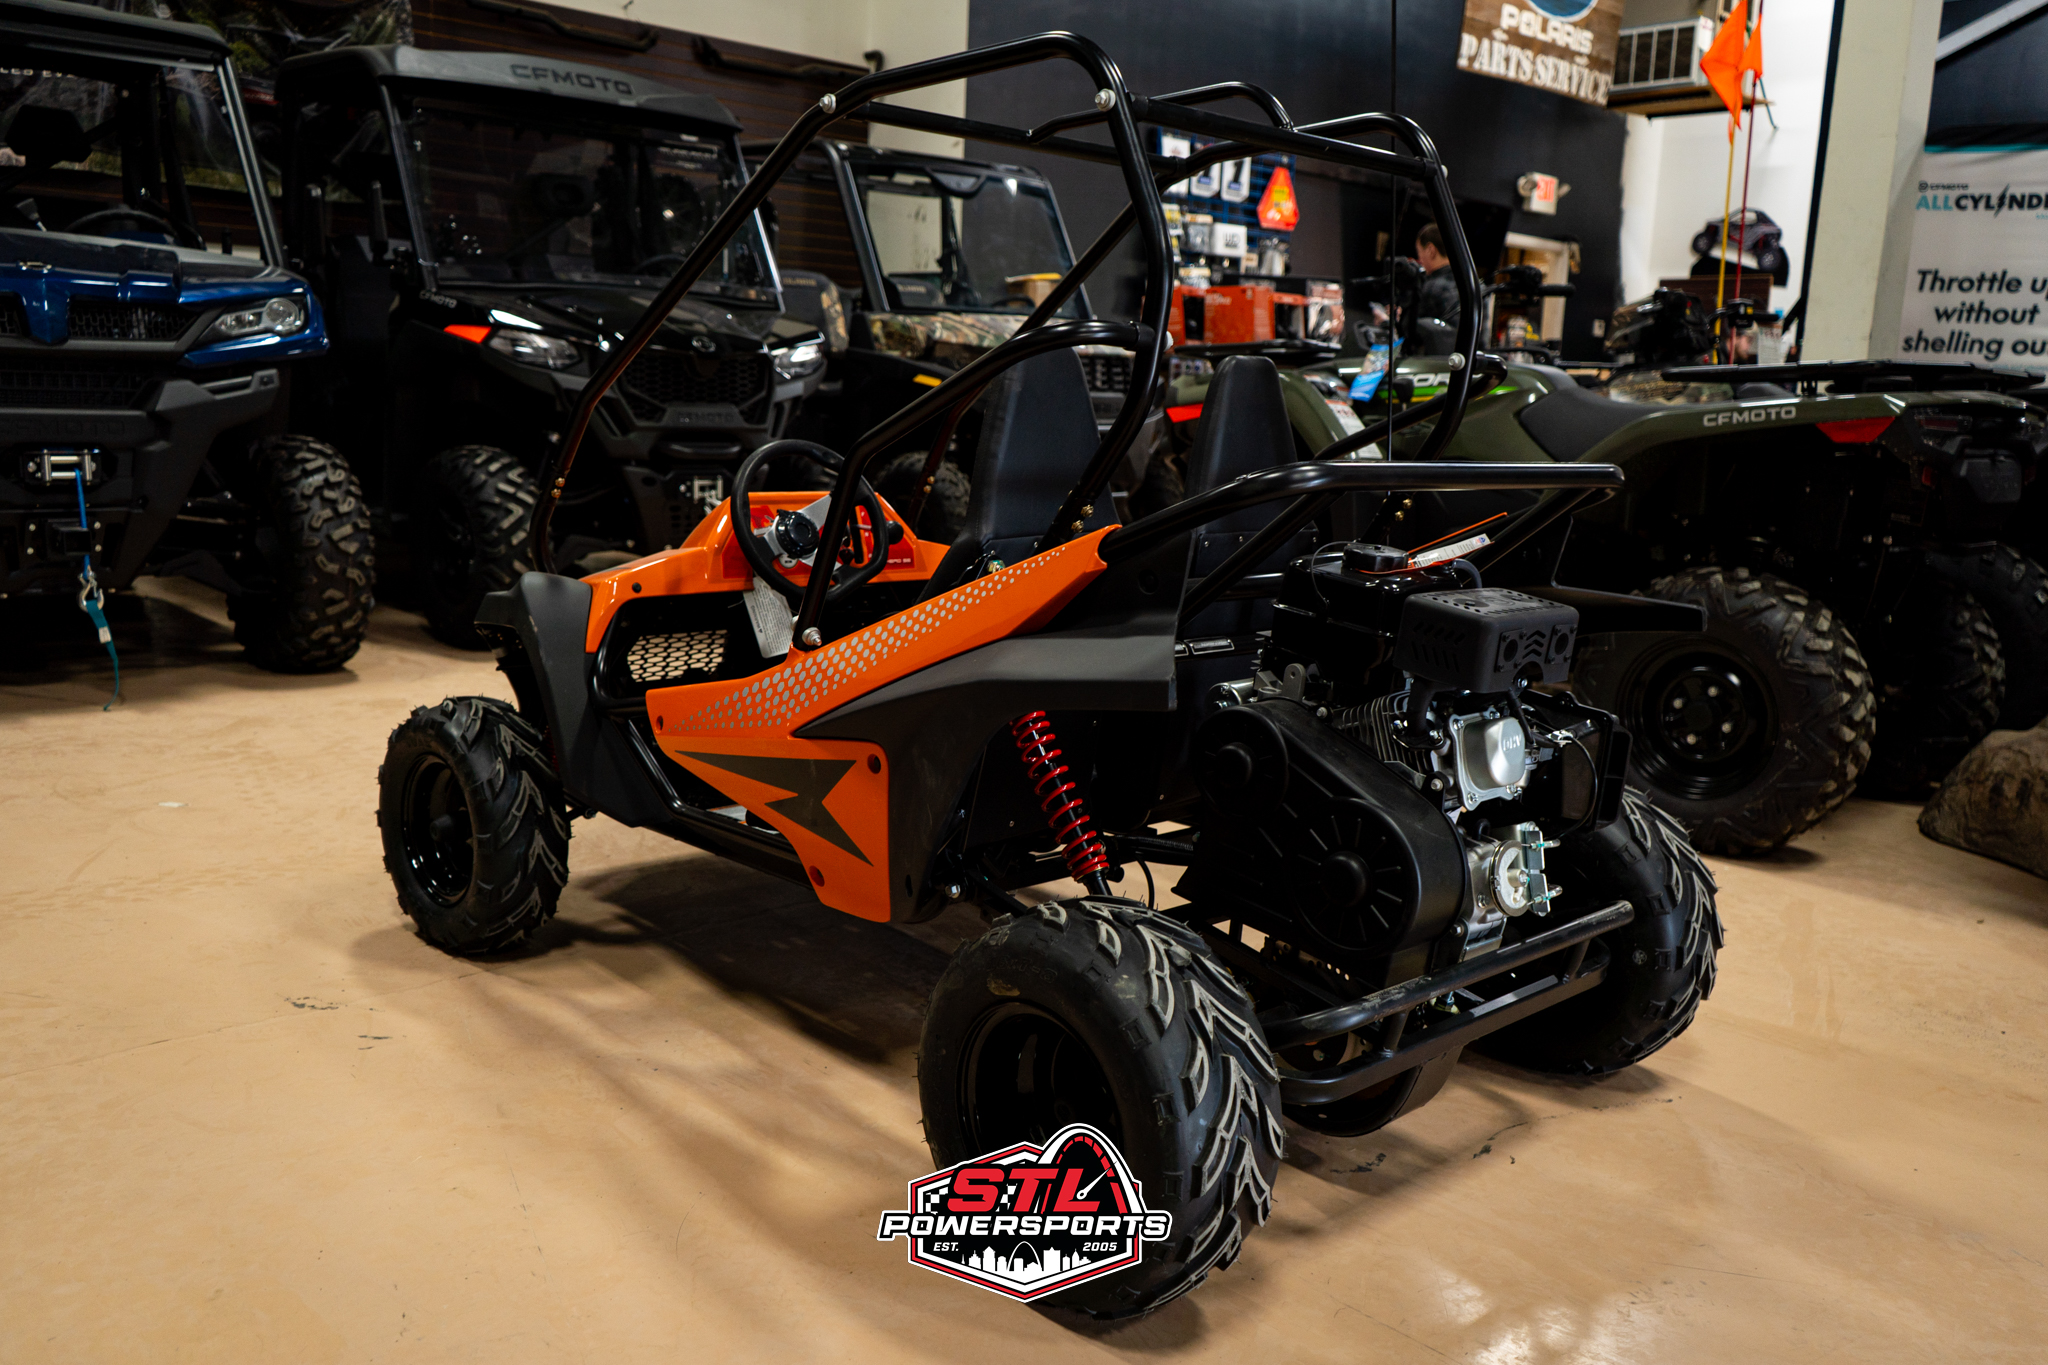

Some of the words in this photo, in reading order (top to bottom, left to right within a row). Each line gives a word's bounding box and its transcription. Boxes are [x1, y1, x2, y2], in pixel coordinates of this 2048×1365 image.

[1500, 3, 1594, 55] POLARIS
[510, 63, 634, 95] CFMOTO
[1457, 32, 1534, 83] PARTS
[1532, 53, 1612, 107] SERVICE
[1917, 268, 2022, 294] Throttle
[1934, 299, 2041, 326] without
[1902, 328, 2004, 363] shelling
[1702, 406, 1797, 427] CFMOTO
